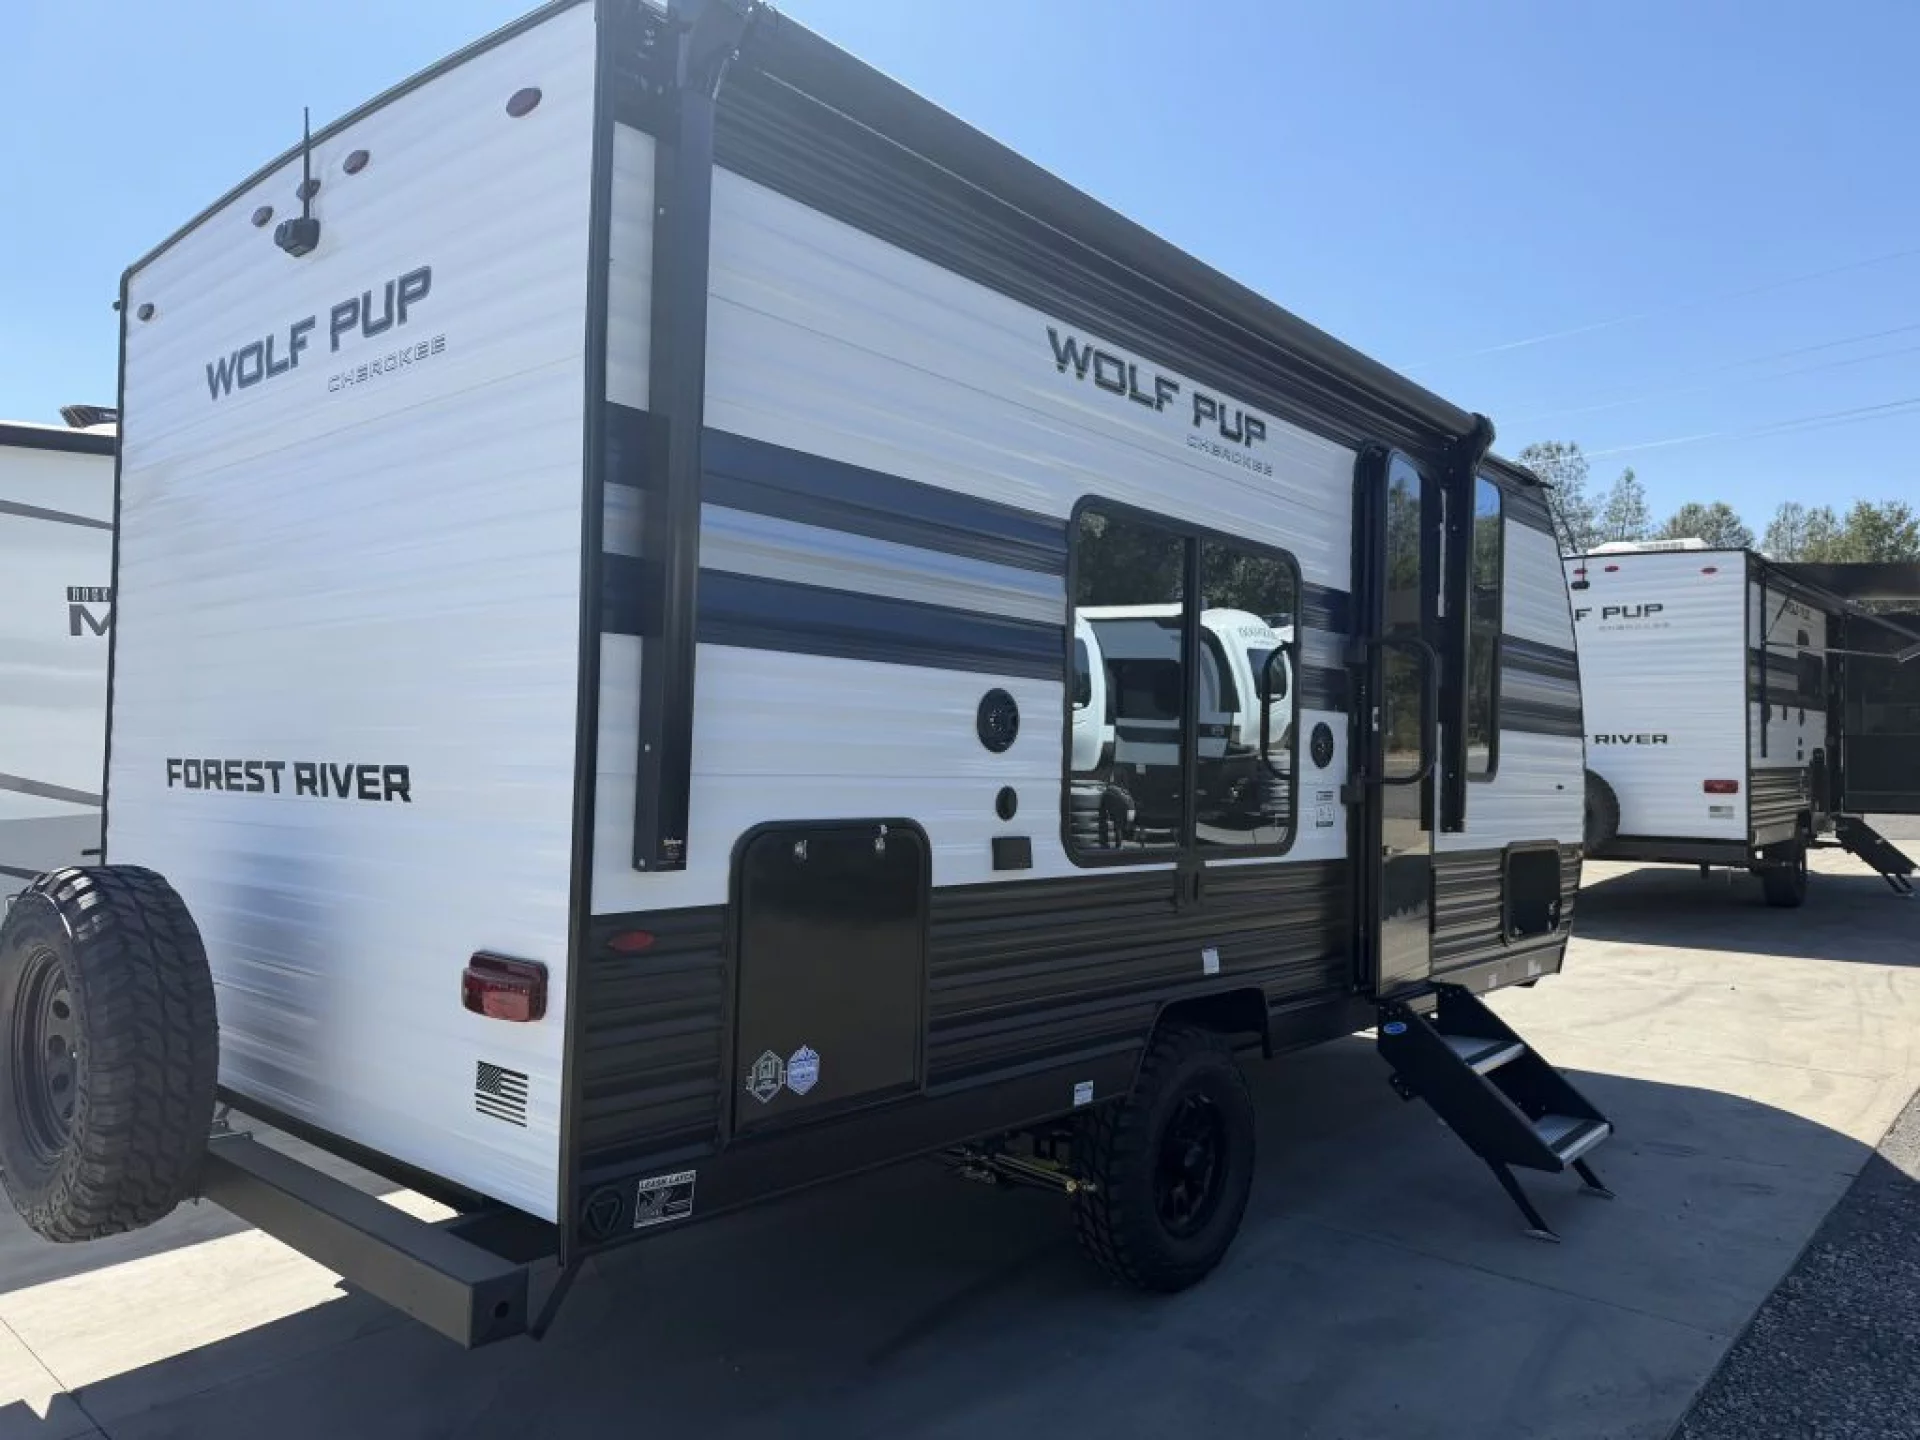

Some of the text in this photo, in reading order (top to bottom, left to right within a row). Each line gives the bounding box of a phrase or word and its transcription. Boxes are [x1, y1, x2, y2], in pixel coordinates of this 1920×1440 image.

[206, 265, 432, 401] WOLF PUP
[328, 334, 446, 392] CHEROKEE
[1046, 325, 1267, 447] WOLF PUP
[1602, 603, 1663, 620] PUP
[1594, 734, 1668, 745] RIVER
[166, 758, 412, 803] FOREST RIVER
